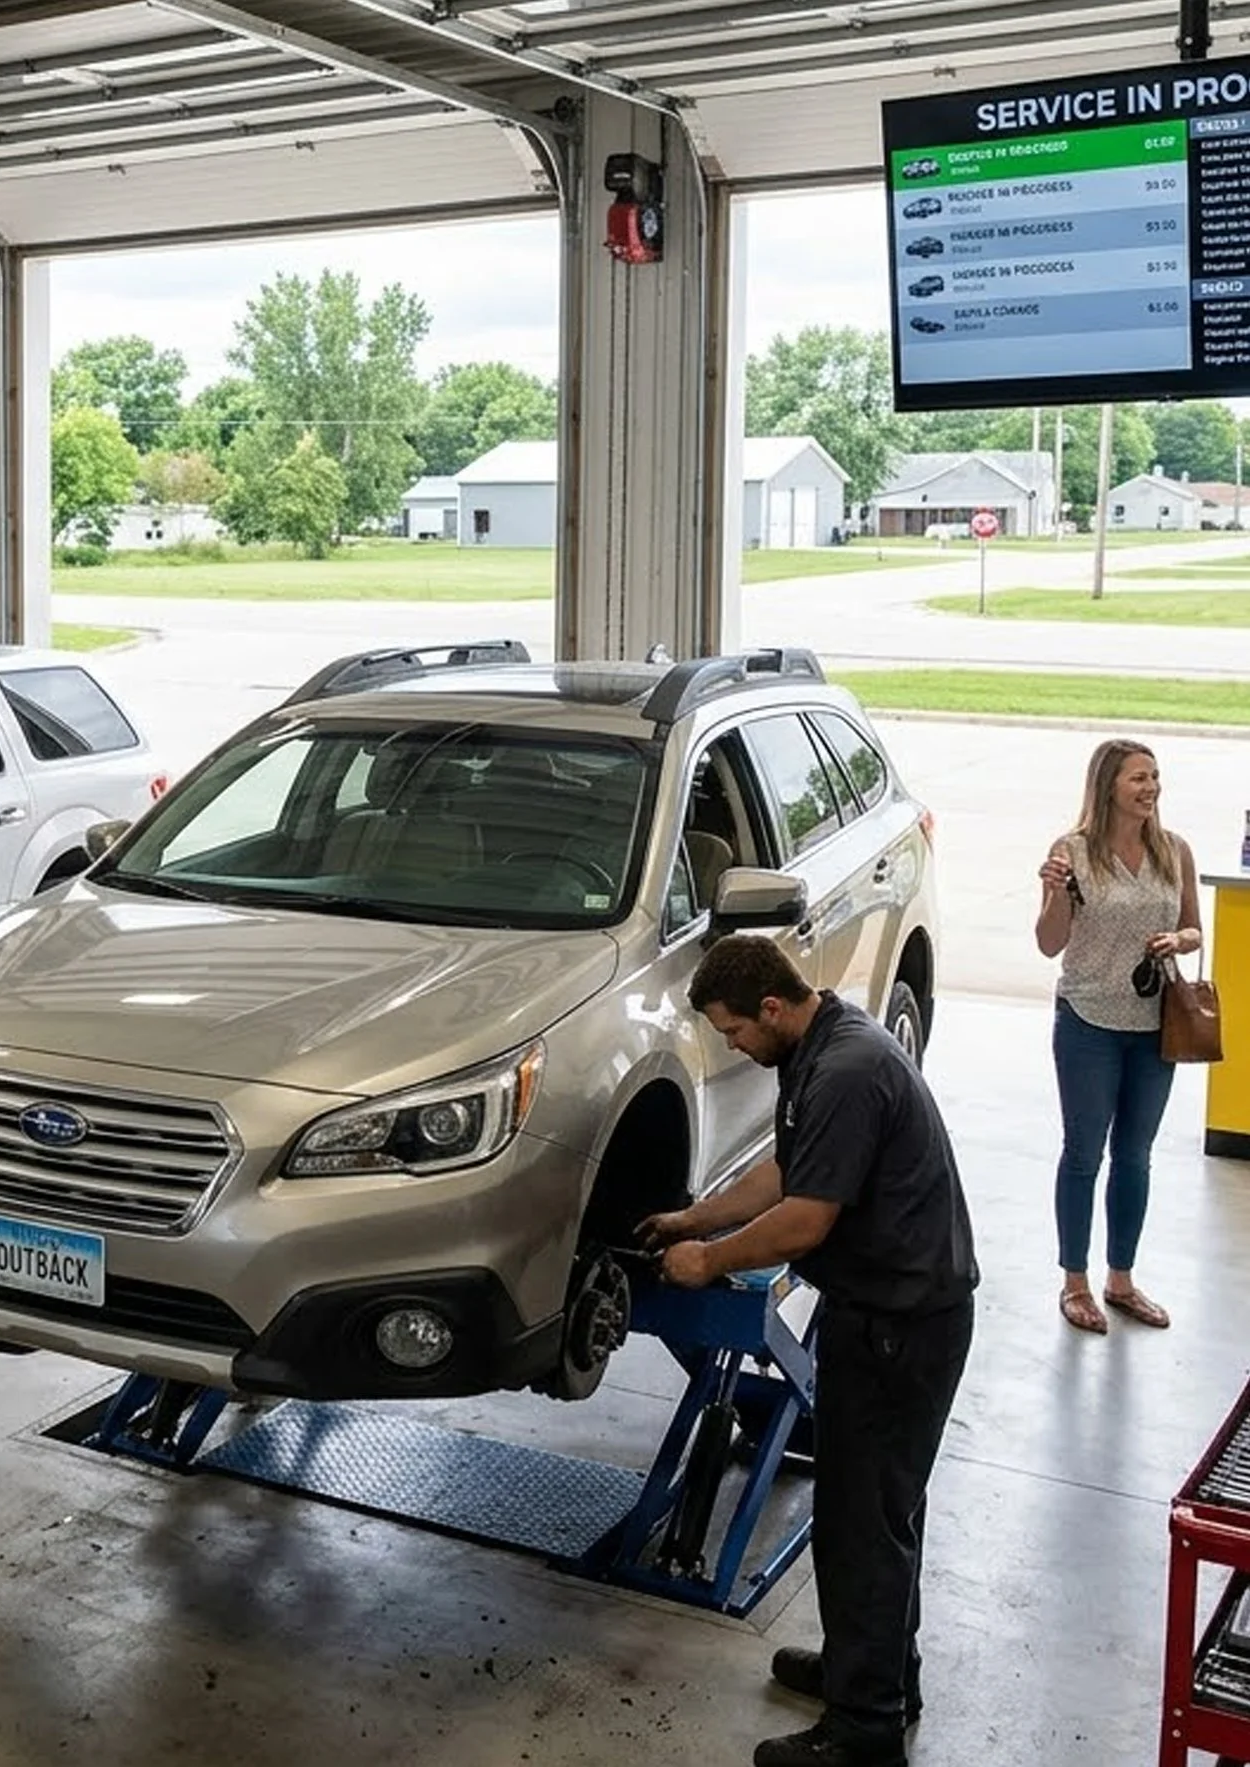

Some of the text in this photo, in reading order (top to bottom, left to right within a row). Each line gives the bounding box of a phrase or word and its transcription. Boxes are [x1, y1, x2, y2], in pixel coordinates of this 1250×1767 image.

[976, 72, 1250, 132] SERVICE IN PRO
